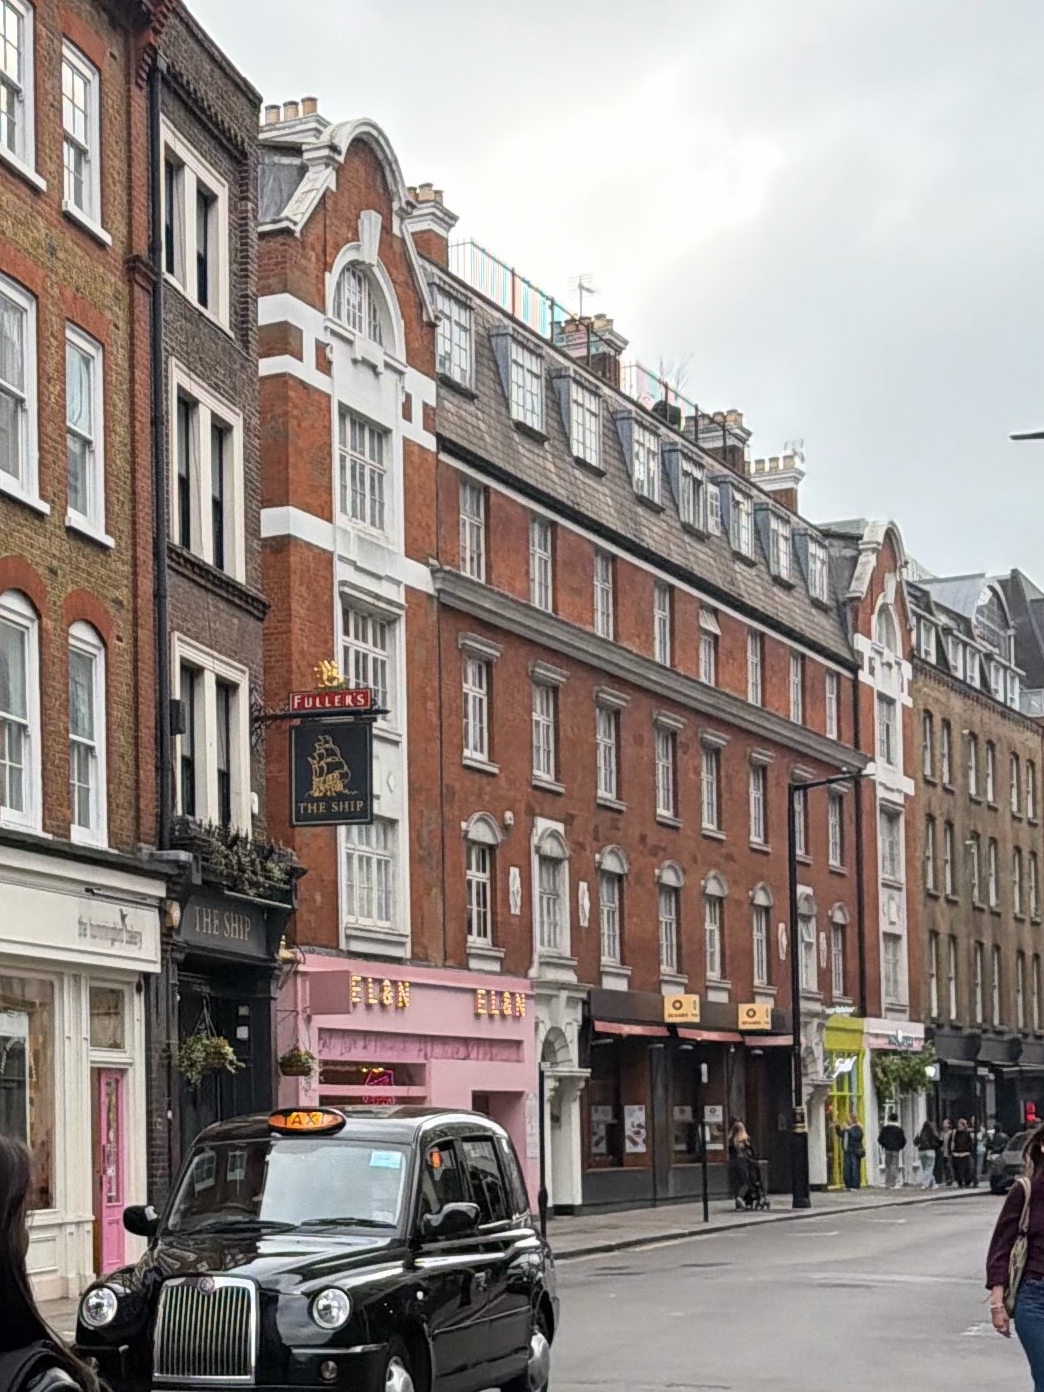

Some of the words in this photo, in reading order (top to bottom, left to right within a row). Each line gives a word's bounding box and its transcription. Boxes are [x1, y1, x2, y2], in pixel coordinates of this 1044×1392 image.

[293, 692, 365, 709] FULLER'S
[299, 802, 327, 814] THE
[331, 800, 364, 813] SHIP
[195, 906, 220, 935] THE
[223, 911, 251, 941] SHIP
[351, 975, 410, 1008] EL&N
[476, 989, 526, 1017] EL&N
[282, 1113, 325, 1126] TAXI
